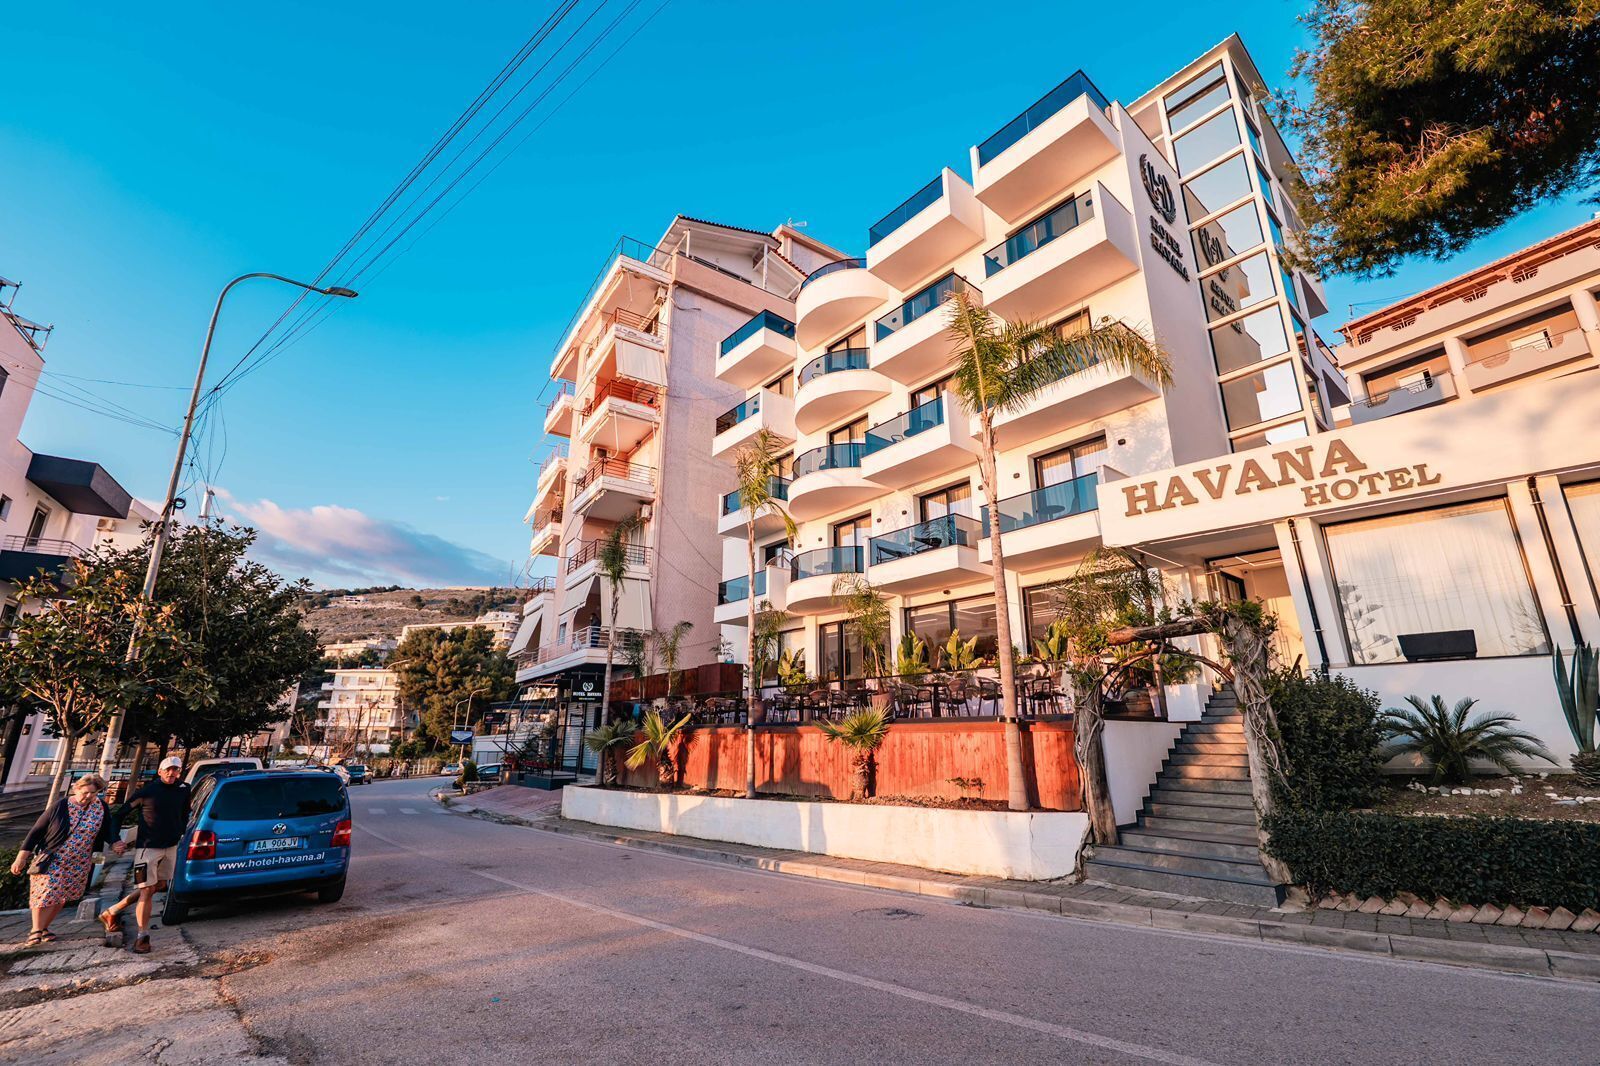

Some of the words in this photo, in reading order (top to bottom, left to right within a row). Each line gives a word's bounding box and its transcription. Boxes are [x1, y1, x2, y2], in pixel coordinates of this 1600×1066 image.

[1150, 215, 1183, 258] HOTEL
[1150, 233, 1190, 281] HAVANA
[1121, 438, 1368, 517] HAVANA
[1300, 463, 1442, 508] HOTEL
[218, 852, 325, 871] www.hotel-havana.al
[256, 840, 267, 850] AA
[271, 839, 287, 848] 906
